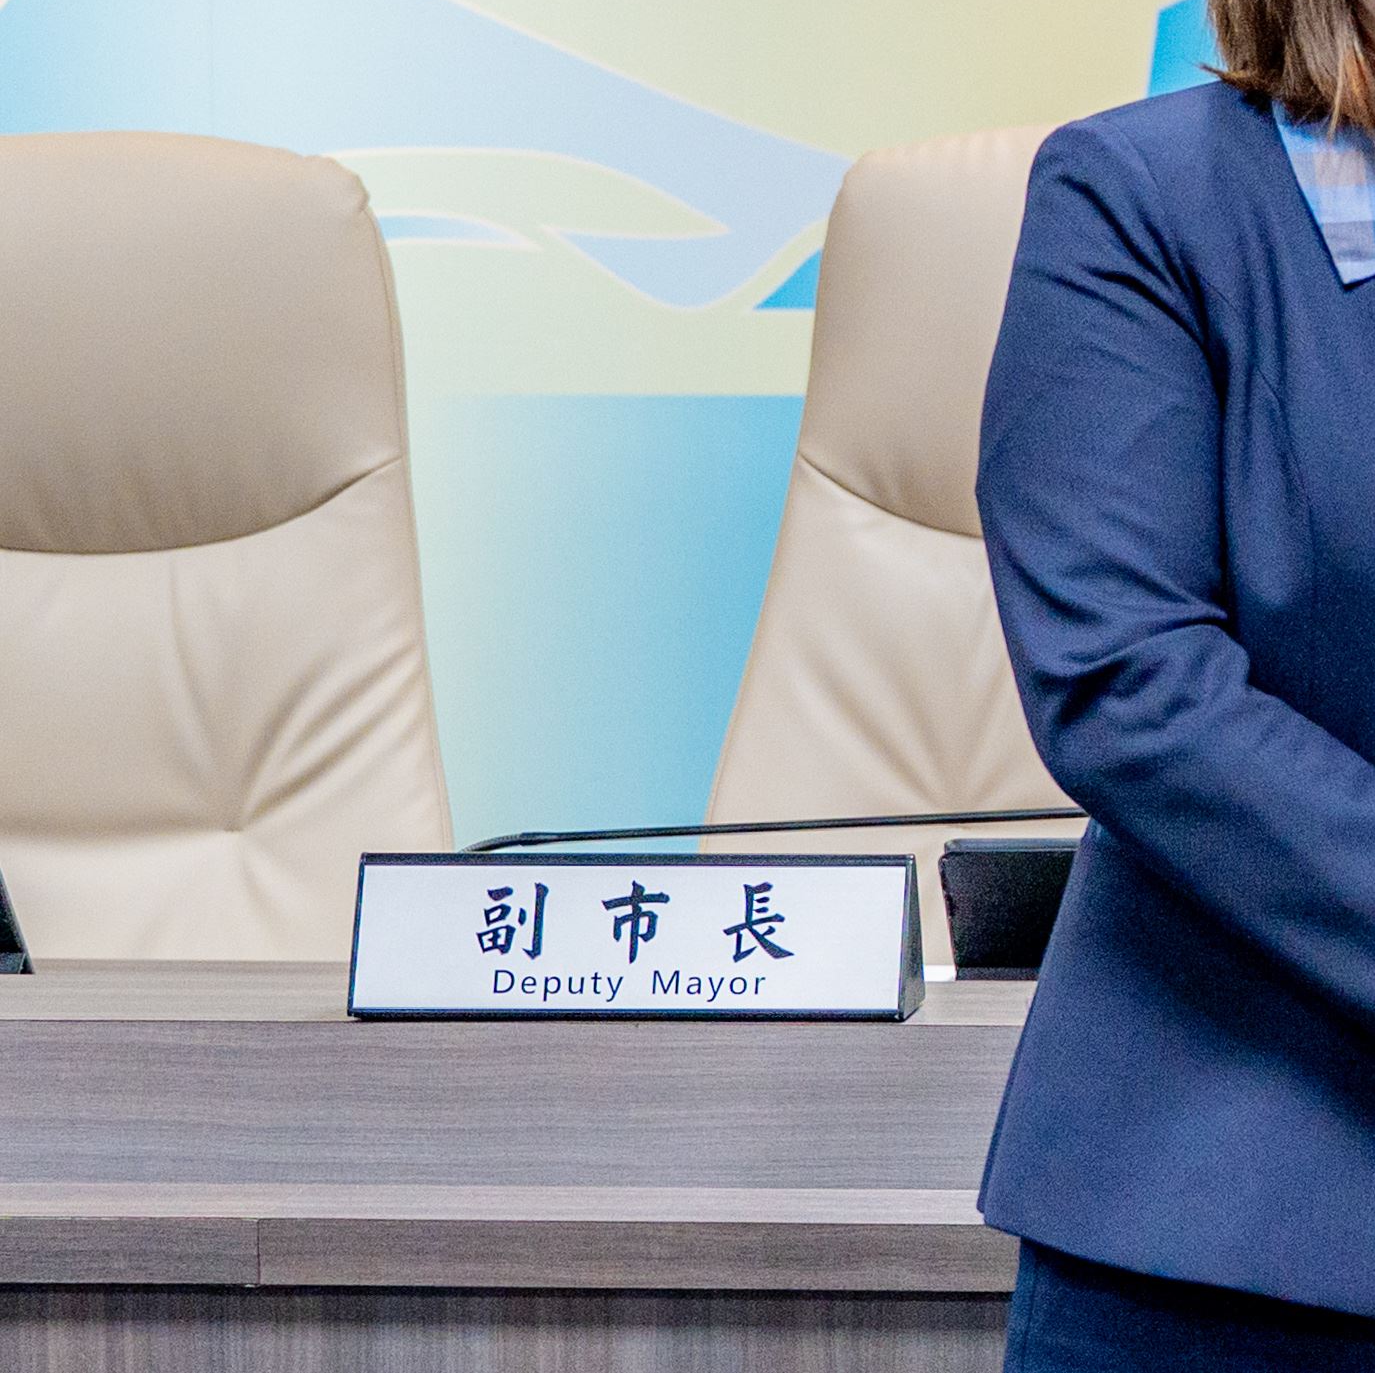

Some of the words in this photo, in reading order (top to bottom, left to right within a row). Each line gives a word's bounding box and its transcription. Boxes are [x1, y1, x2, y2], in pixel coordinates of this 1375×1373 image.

[476, 880, 795, 965] 副市長
[492, 969, 624, 1002] Deputy
[652, 970, 767, 1003] Mayor
